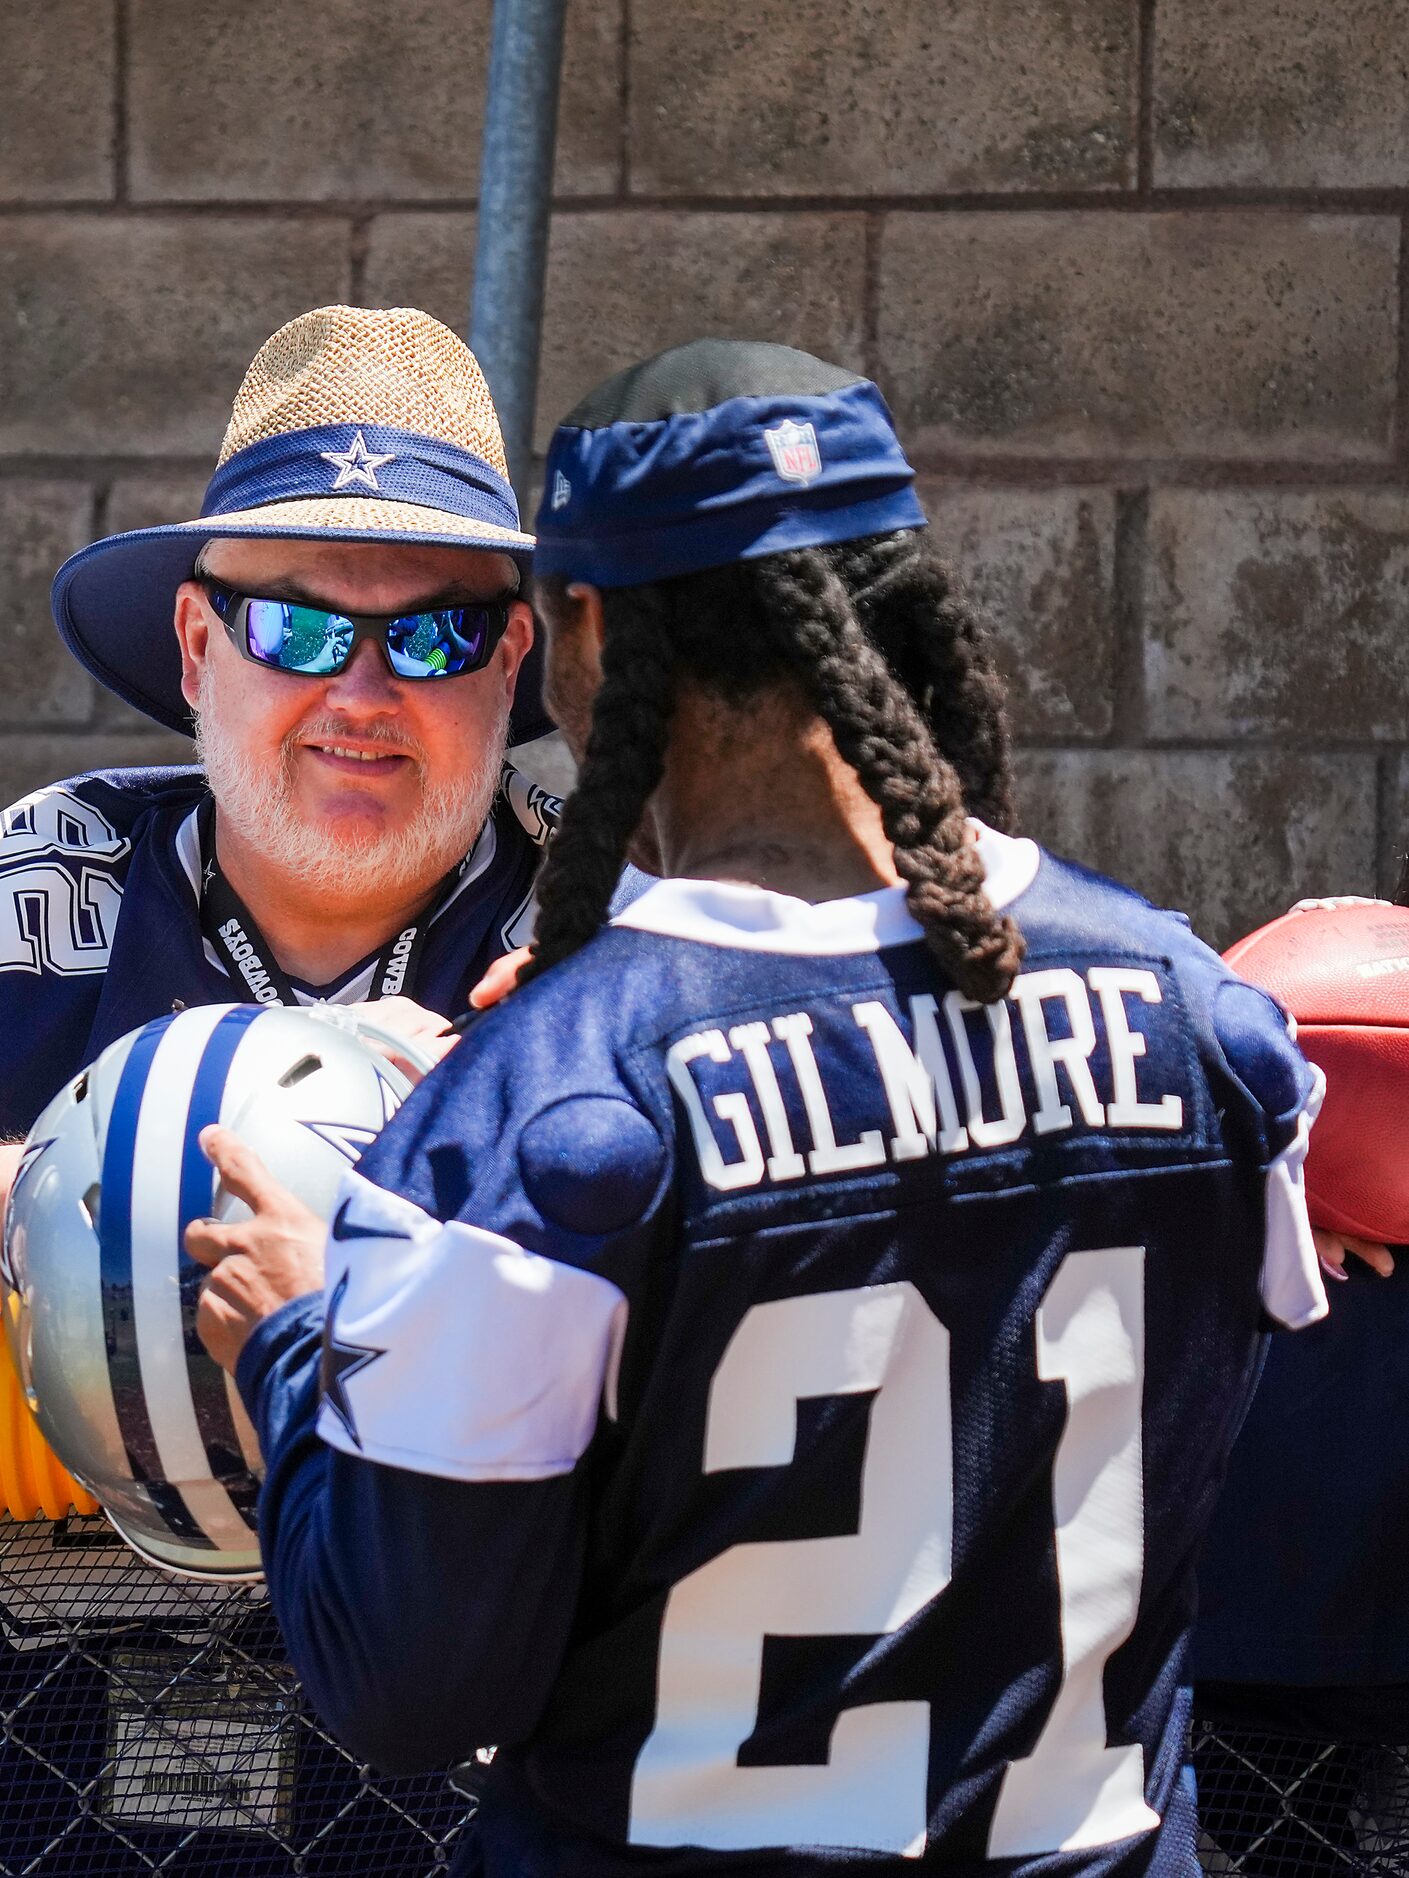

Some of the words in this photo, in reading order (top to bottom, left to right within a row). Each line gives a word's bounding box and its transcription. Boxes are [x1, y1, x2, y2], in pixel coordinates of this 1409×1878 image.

[783, 445, 817, 473] NFL
[217, 917, 284, 1007] OWBOYS
[380, 926, 418, 1001] COWB
[666, 966, 1184, 1192] GILMORE
[626, 1245, 1162, 1861] 21
